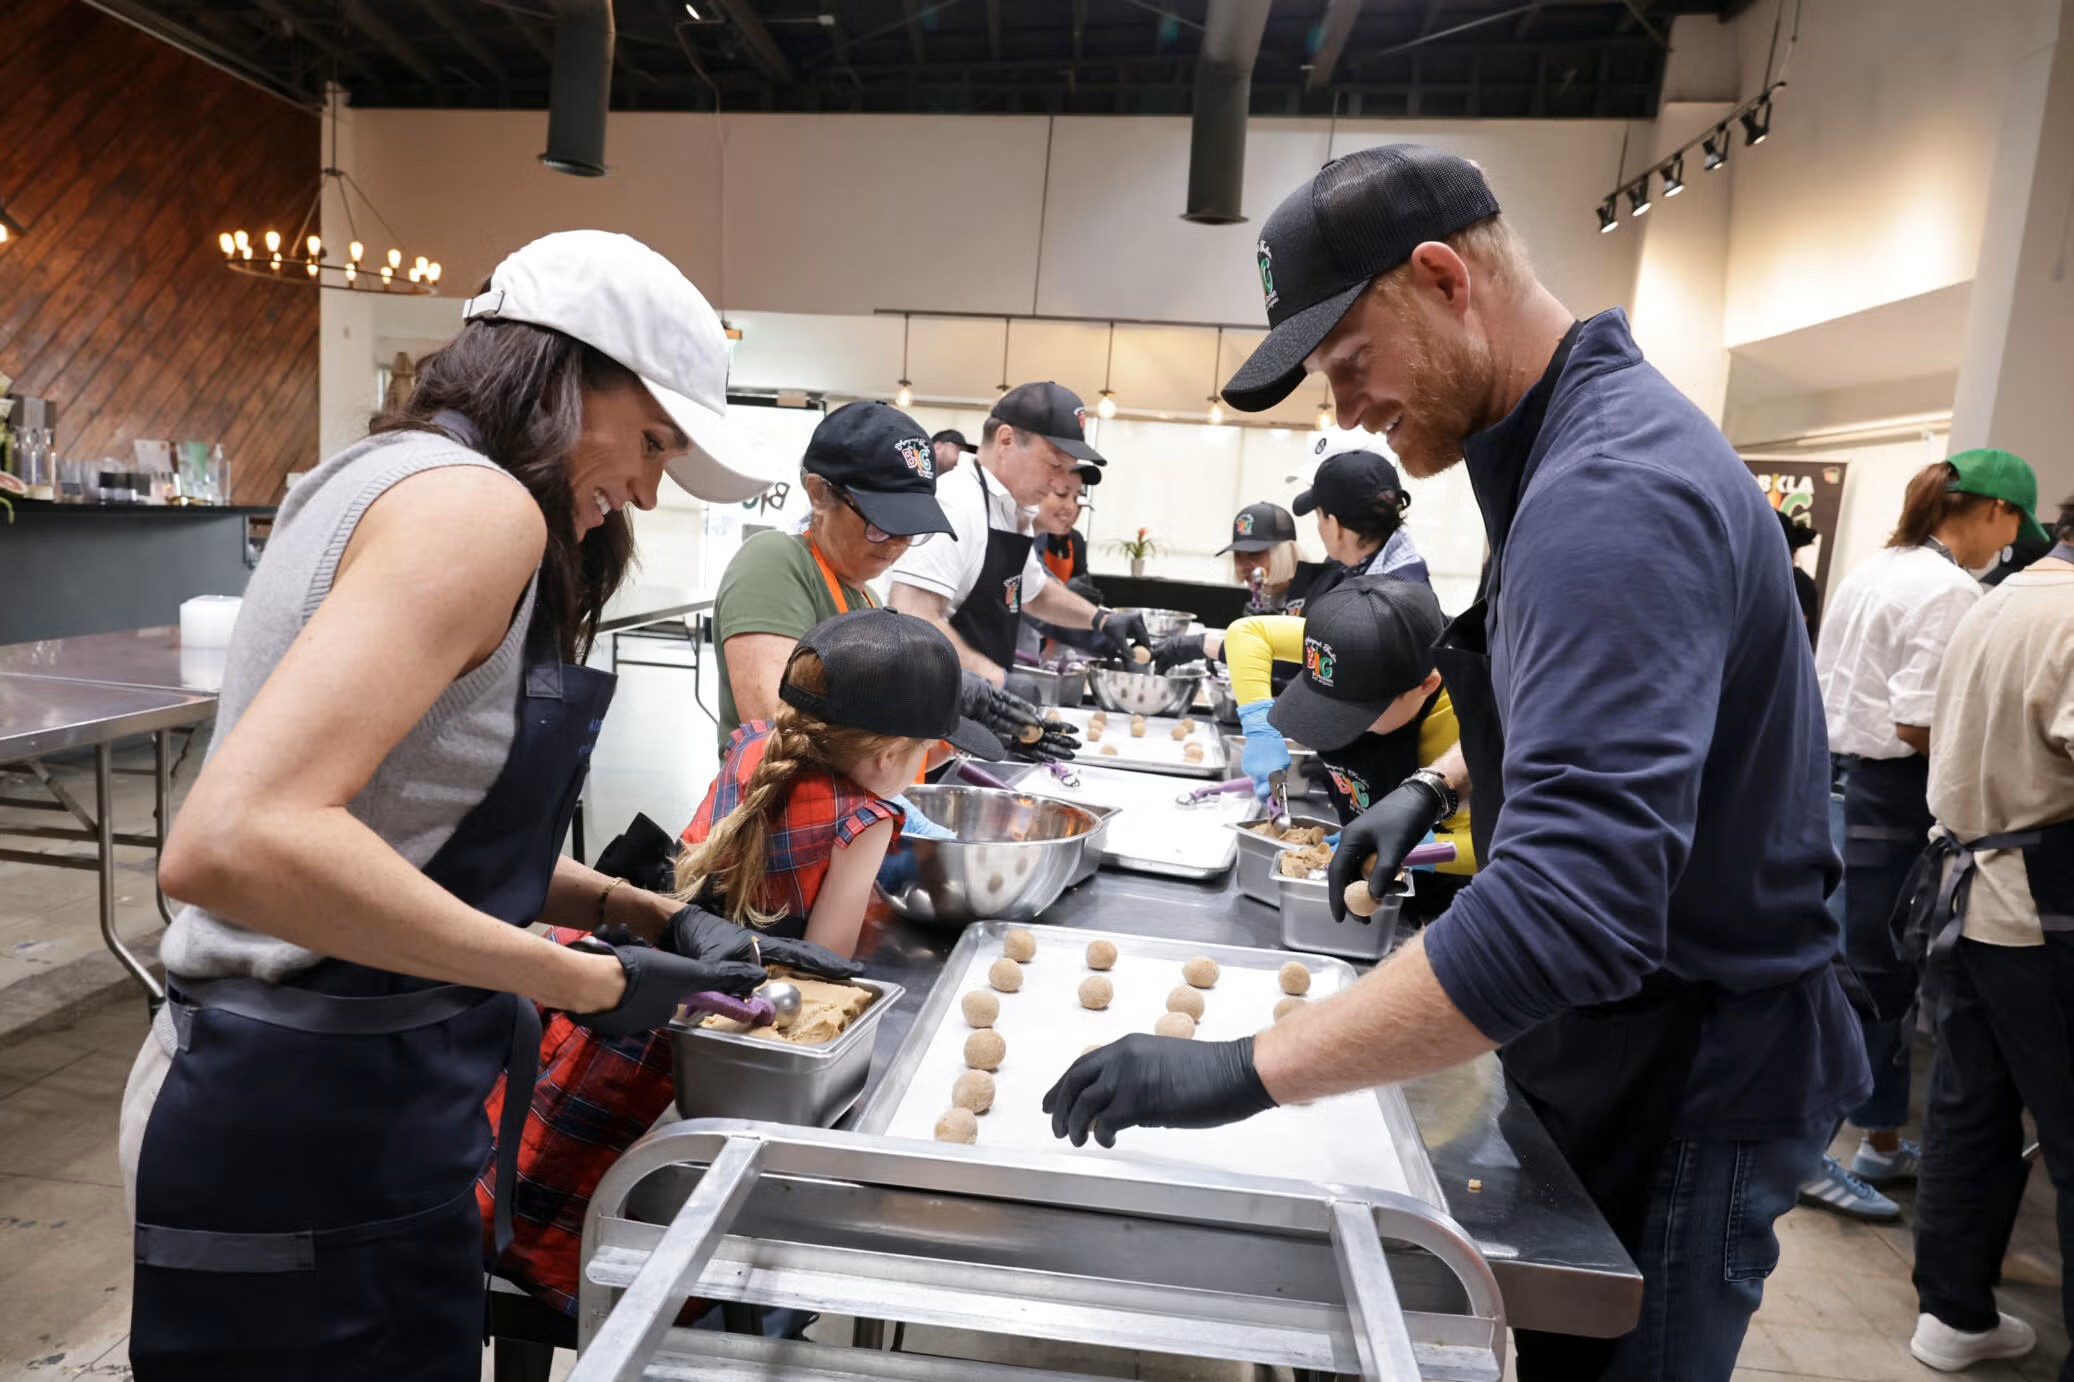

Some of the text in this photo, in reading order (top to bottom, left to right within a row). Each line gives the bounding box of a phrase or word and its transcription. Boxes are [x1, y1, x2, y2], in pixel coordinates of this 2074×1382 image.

[902, 447, 932, 472] BIG
[1752, 474, 1815, 495] BKLA
[1306, 646, 1333, 679] BIG
[1329, 770, 1370, 808] BIG
